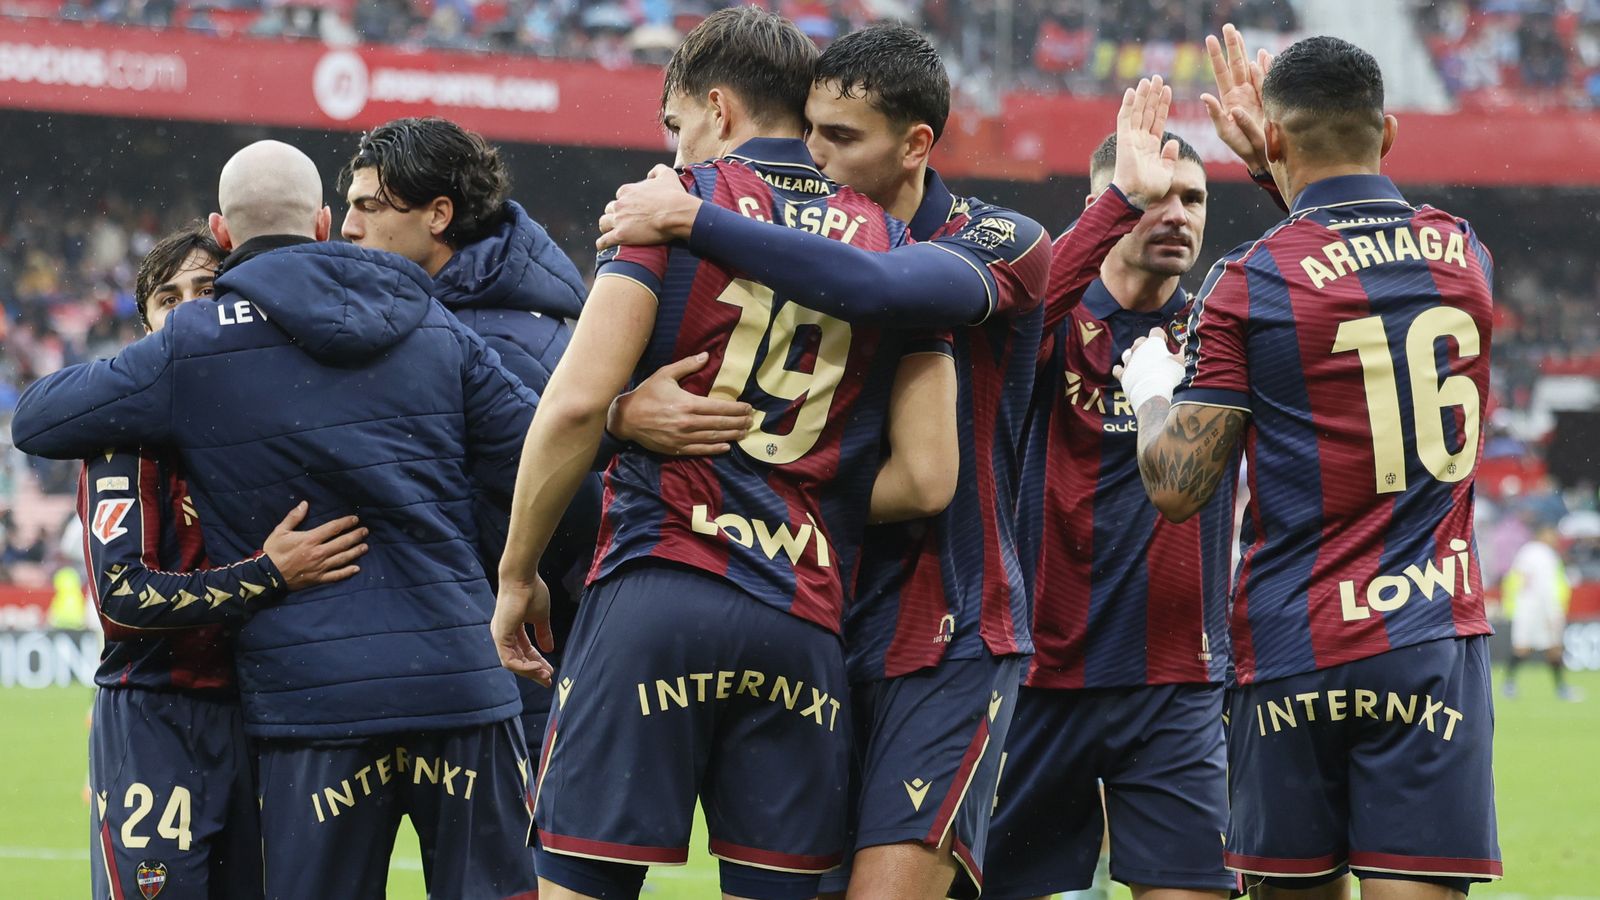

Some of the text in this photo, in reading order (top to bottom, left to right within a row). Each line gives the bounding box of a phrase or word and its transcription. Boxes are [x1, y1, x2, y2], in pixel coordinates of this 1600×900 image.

[1300, 226, 1467, 289] ARRIAGA
[716, 278, 852, 464] 19
[1331, 306, 1481, 494] 16
[637, 670, 841, 732] INTERNXT
[1255, 688, 1463, 741] INTERNXT
[121, 782, 192, 851] 24
[311, 747, 477, 823] INTERNXT
